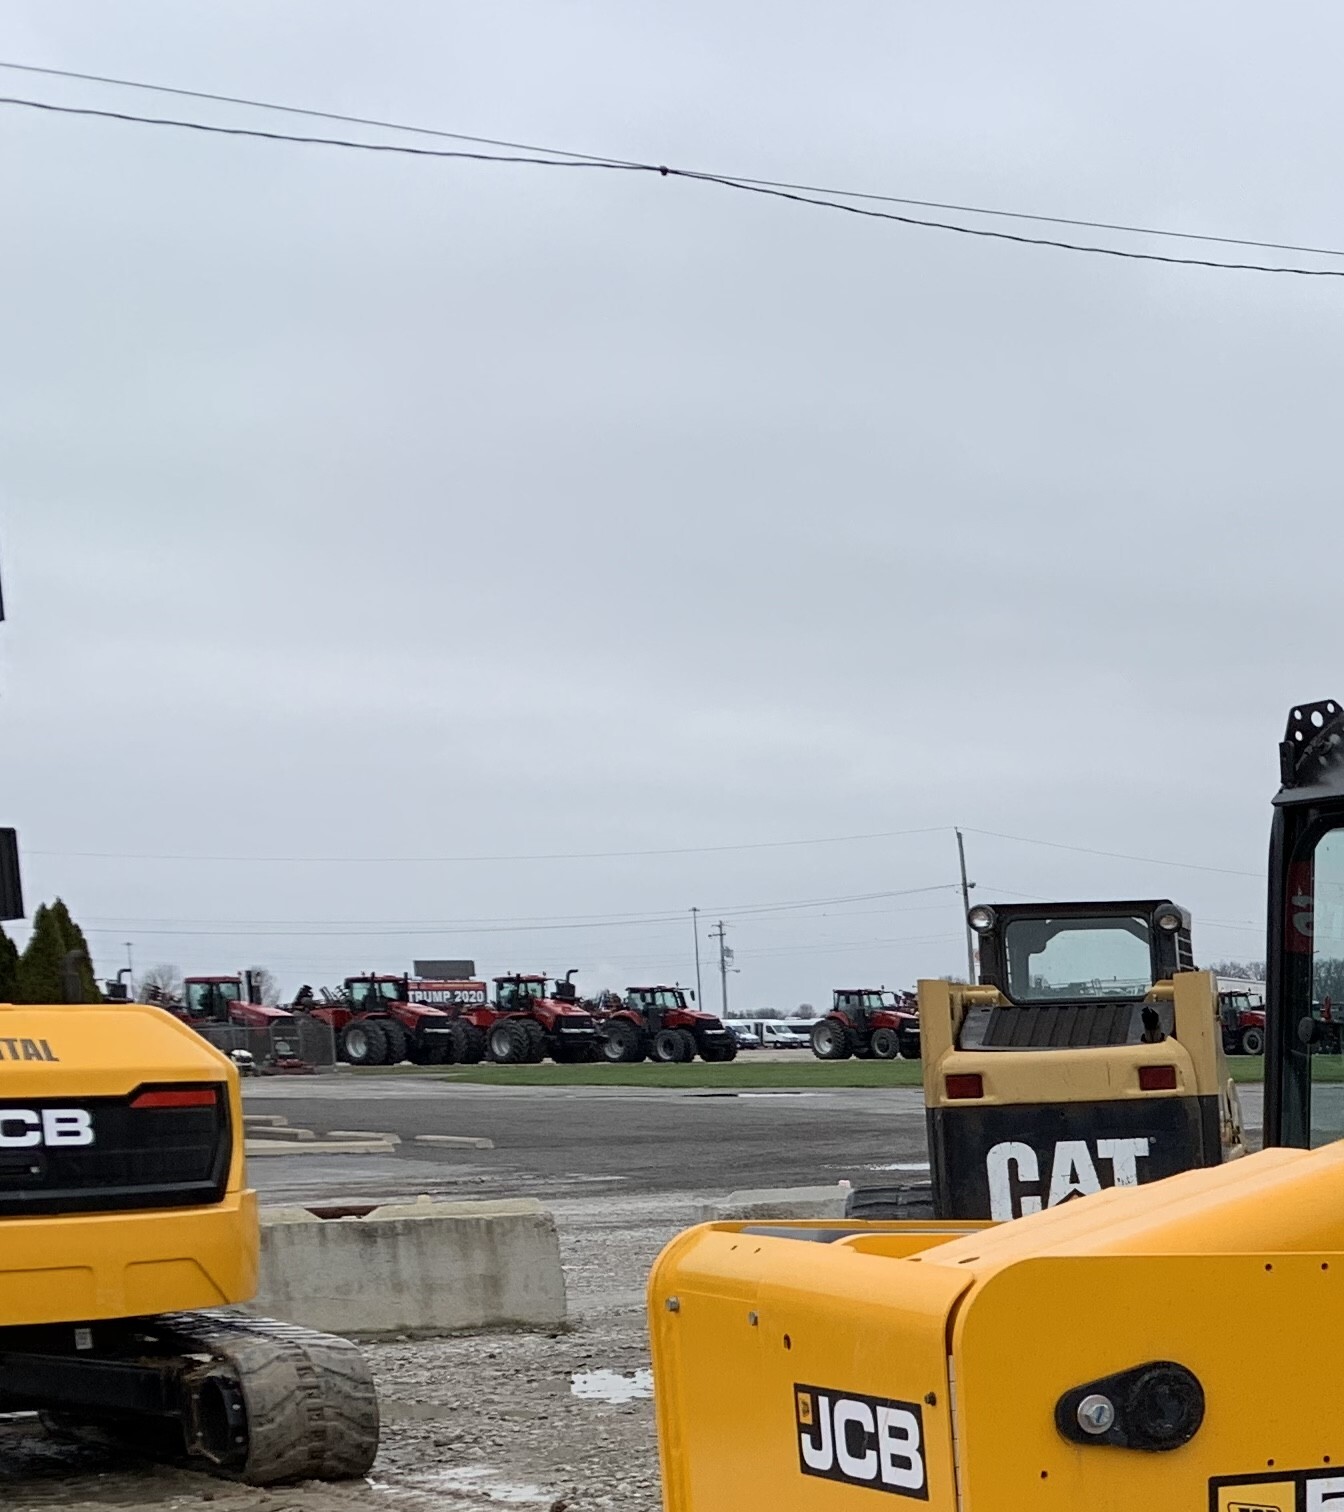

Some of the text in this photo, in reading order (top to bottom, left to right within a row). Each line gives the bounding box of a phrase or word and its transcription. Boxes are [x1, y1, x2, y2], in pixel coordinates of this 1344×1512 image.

[408, 990, 484, 1002] TRUMP 2020
[0, 1037, 60, 1062] TAL
[986, 1137, 1149, 1222] CAT
[801, 1395, 924, 1489] JCB
